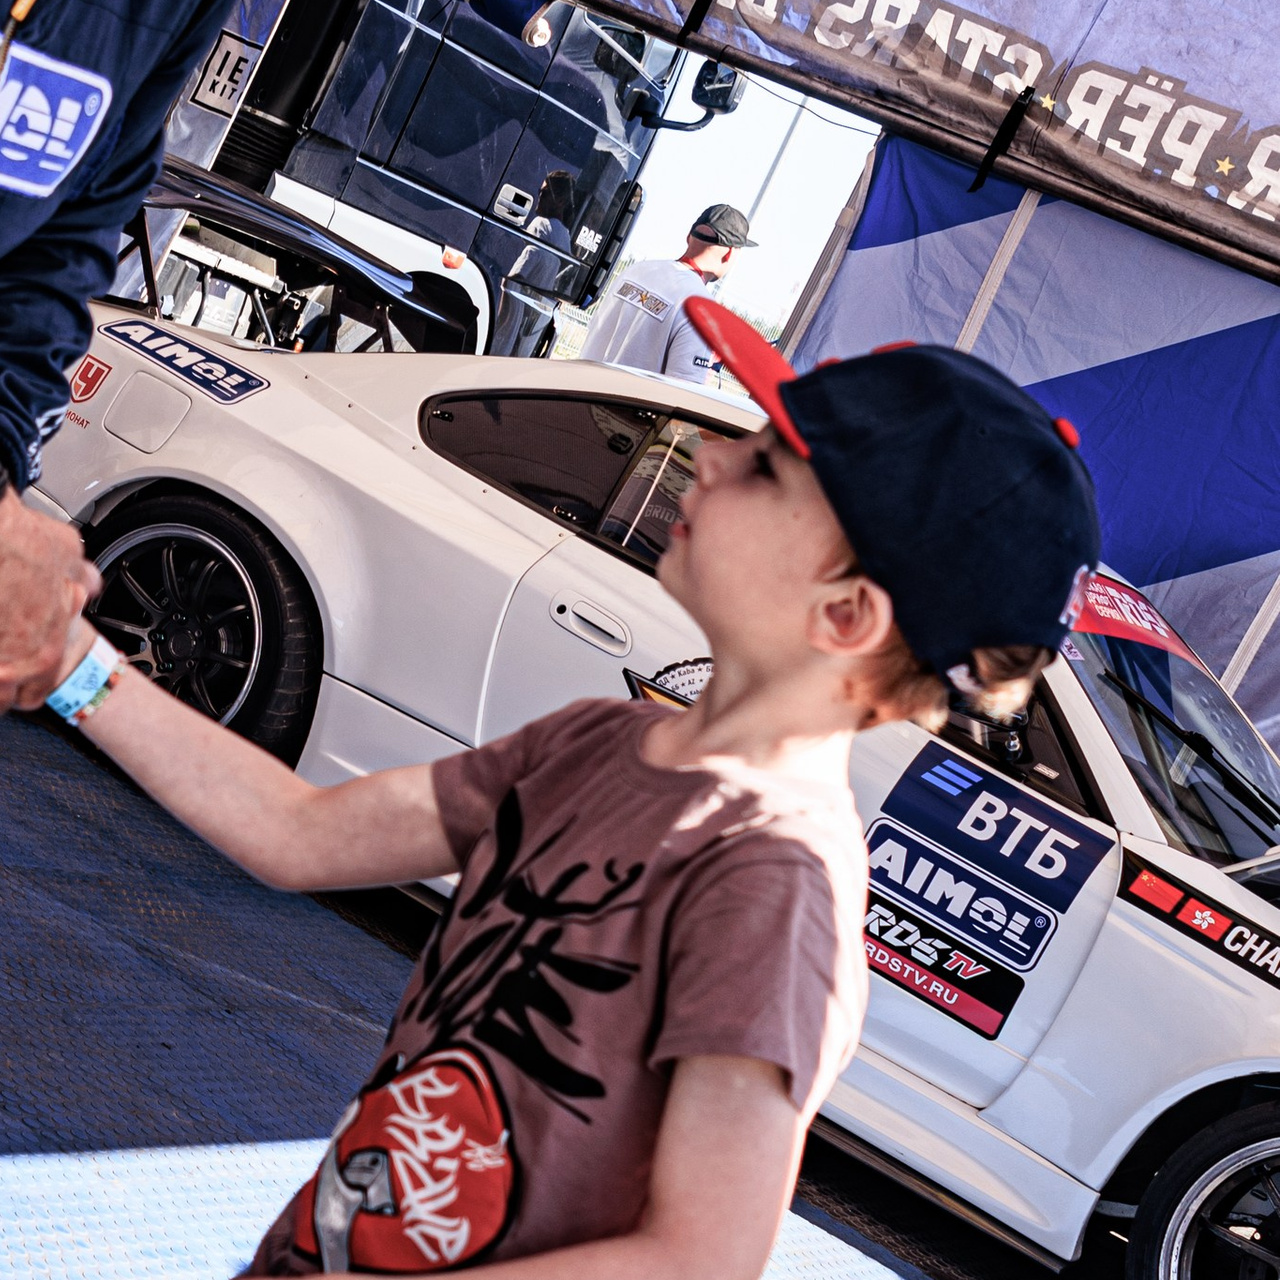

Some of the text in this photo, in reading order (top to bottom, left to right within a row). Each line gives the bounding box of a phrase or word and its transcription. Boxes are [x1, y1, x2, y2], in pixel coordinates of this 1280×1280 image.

[110, 324, 247, 398] AIMOL
[956, 789, 1081, 880] ВТБ
[868, 837, 1032, 958] AIMOL
[864, 940, 959, 1005] RDSTV.RU
[942, 949, 992, 980] TV
[1223, 925, 1280, 979] CHA
